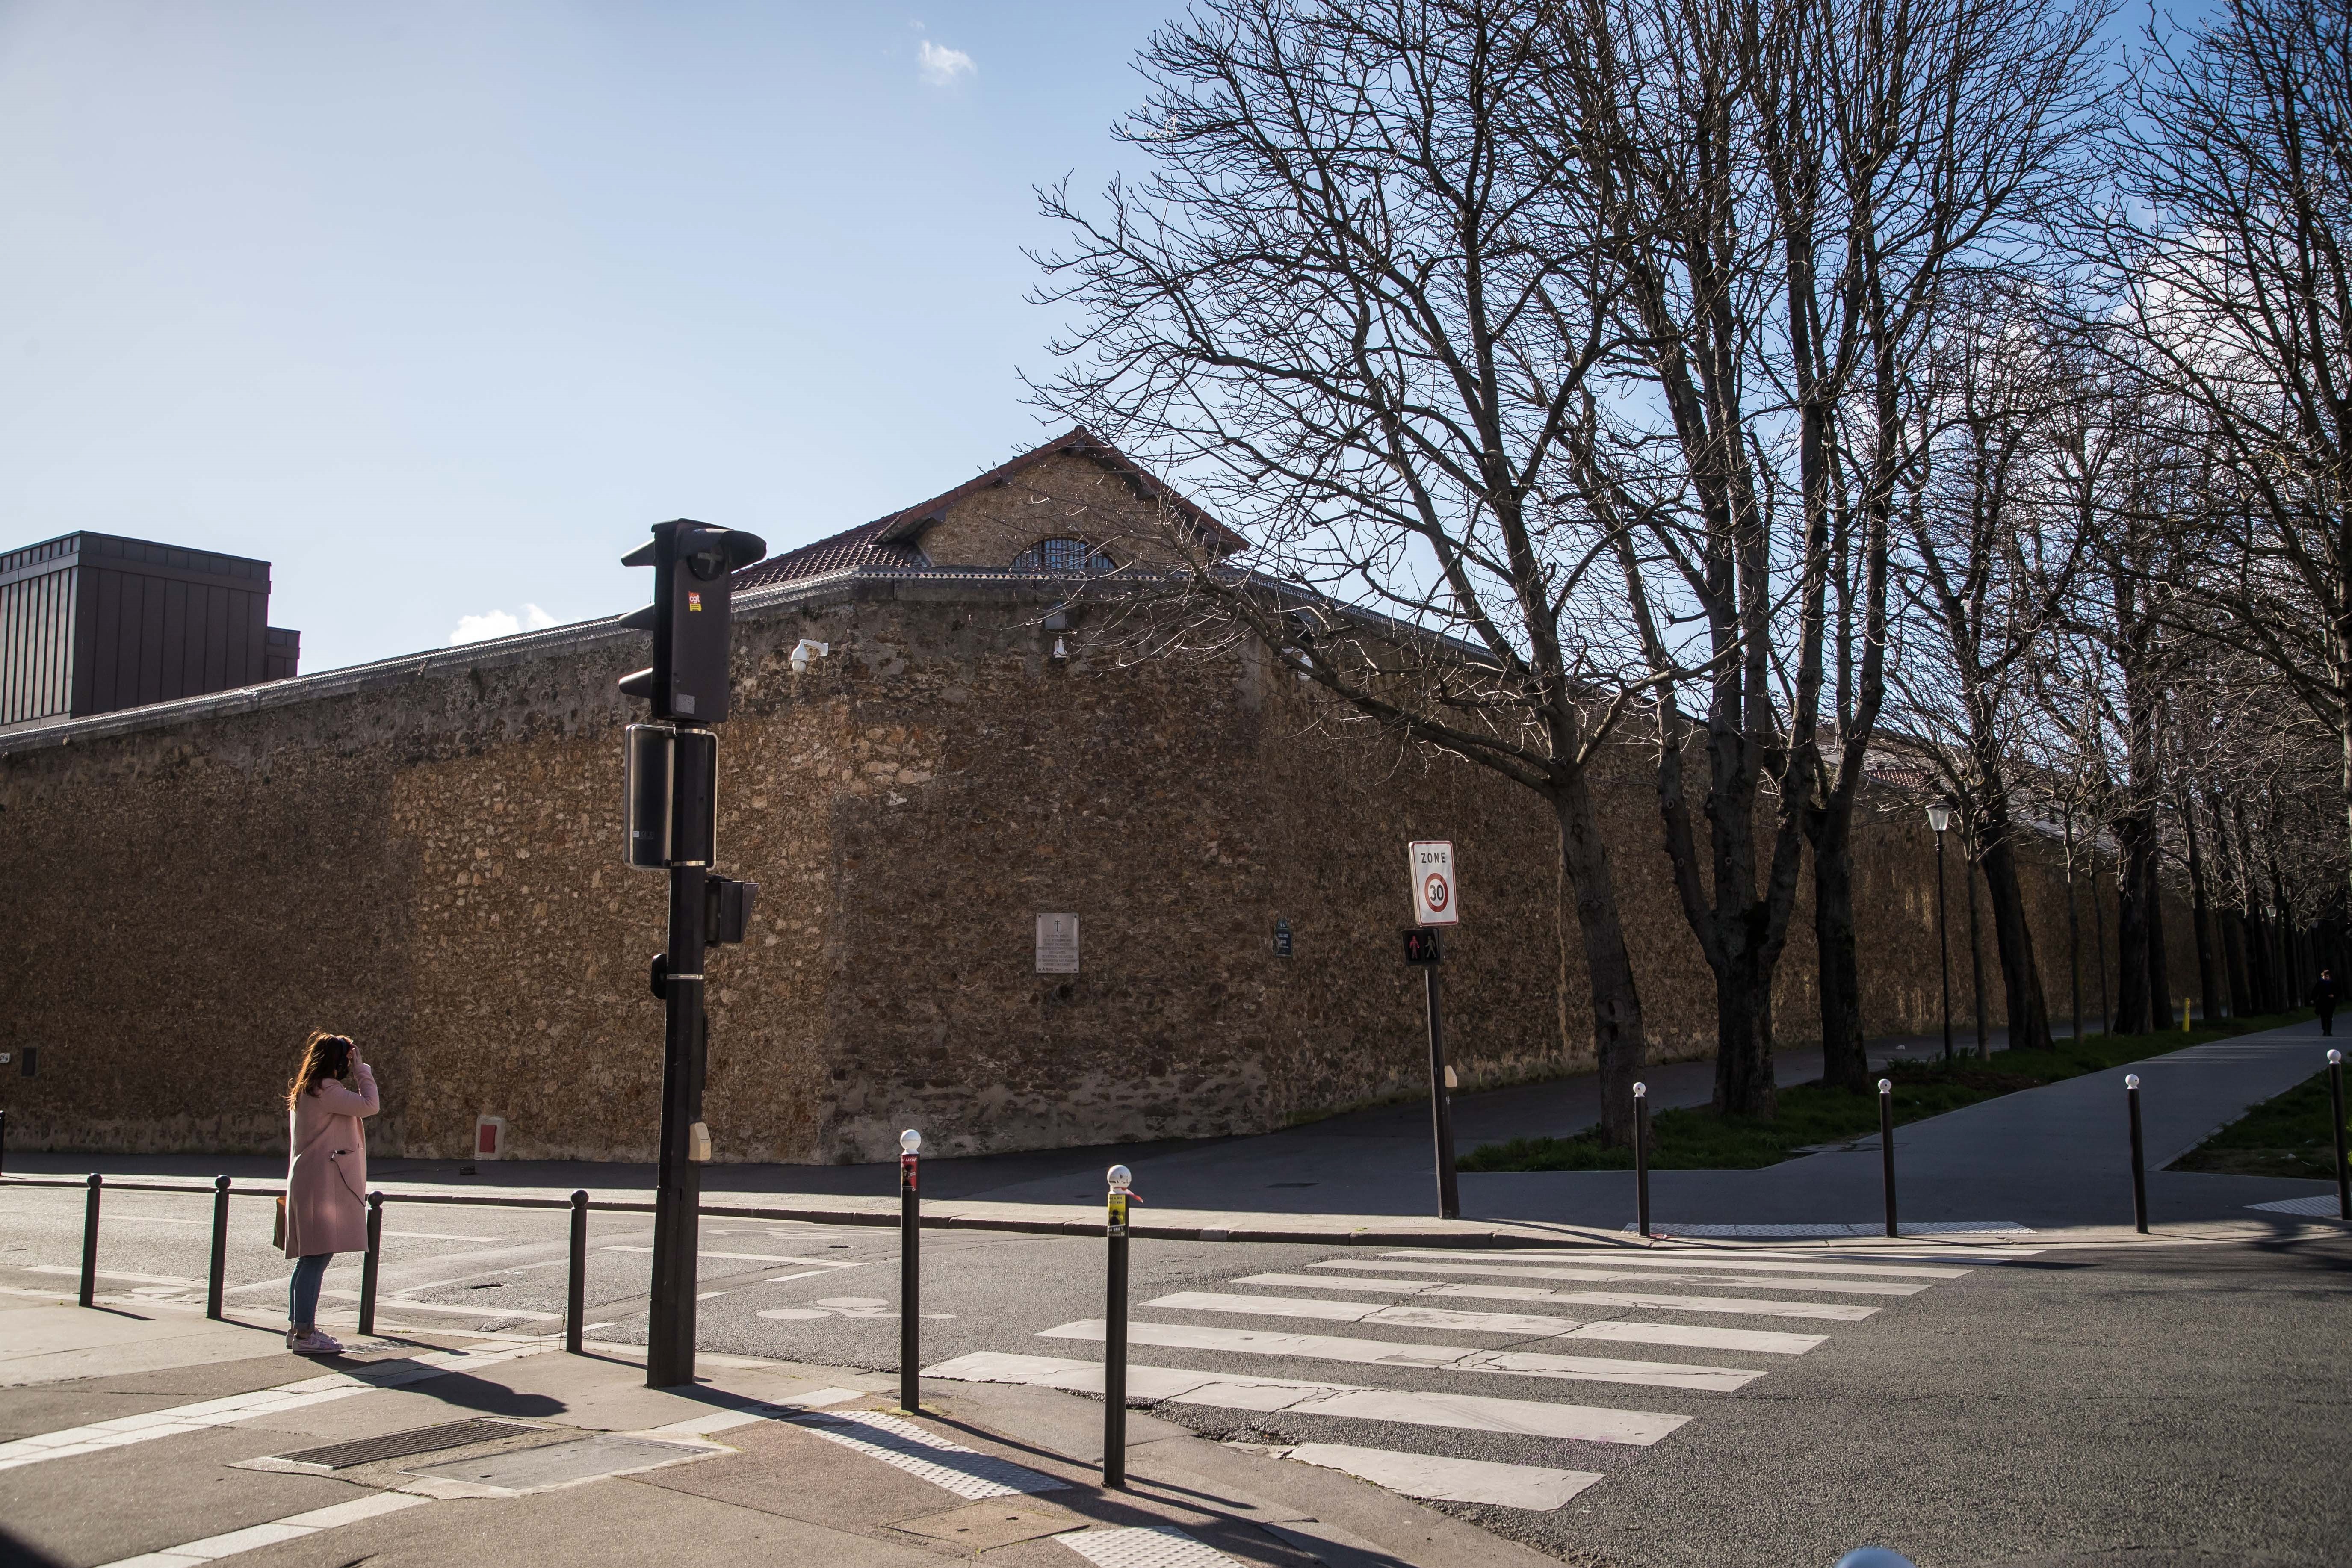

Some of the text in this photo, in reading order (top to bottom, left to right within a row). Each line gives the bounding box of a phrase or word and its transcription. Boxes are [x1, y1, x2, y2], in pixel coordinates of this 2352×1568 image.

[689, 594, 700, 603] cgt
[1421, 852, 1446, 863] ZONE
[1430, 884, 1444, 901] 30
